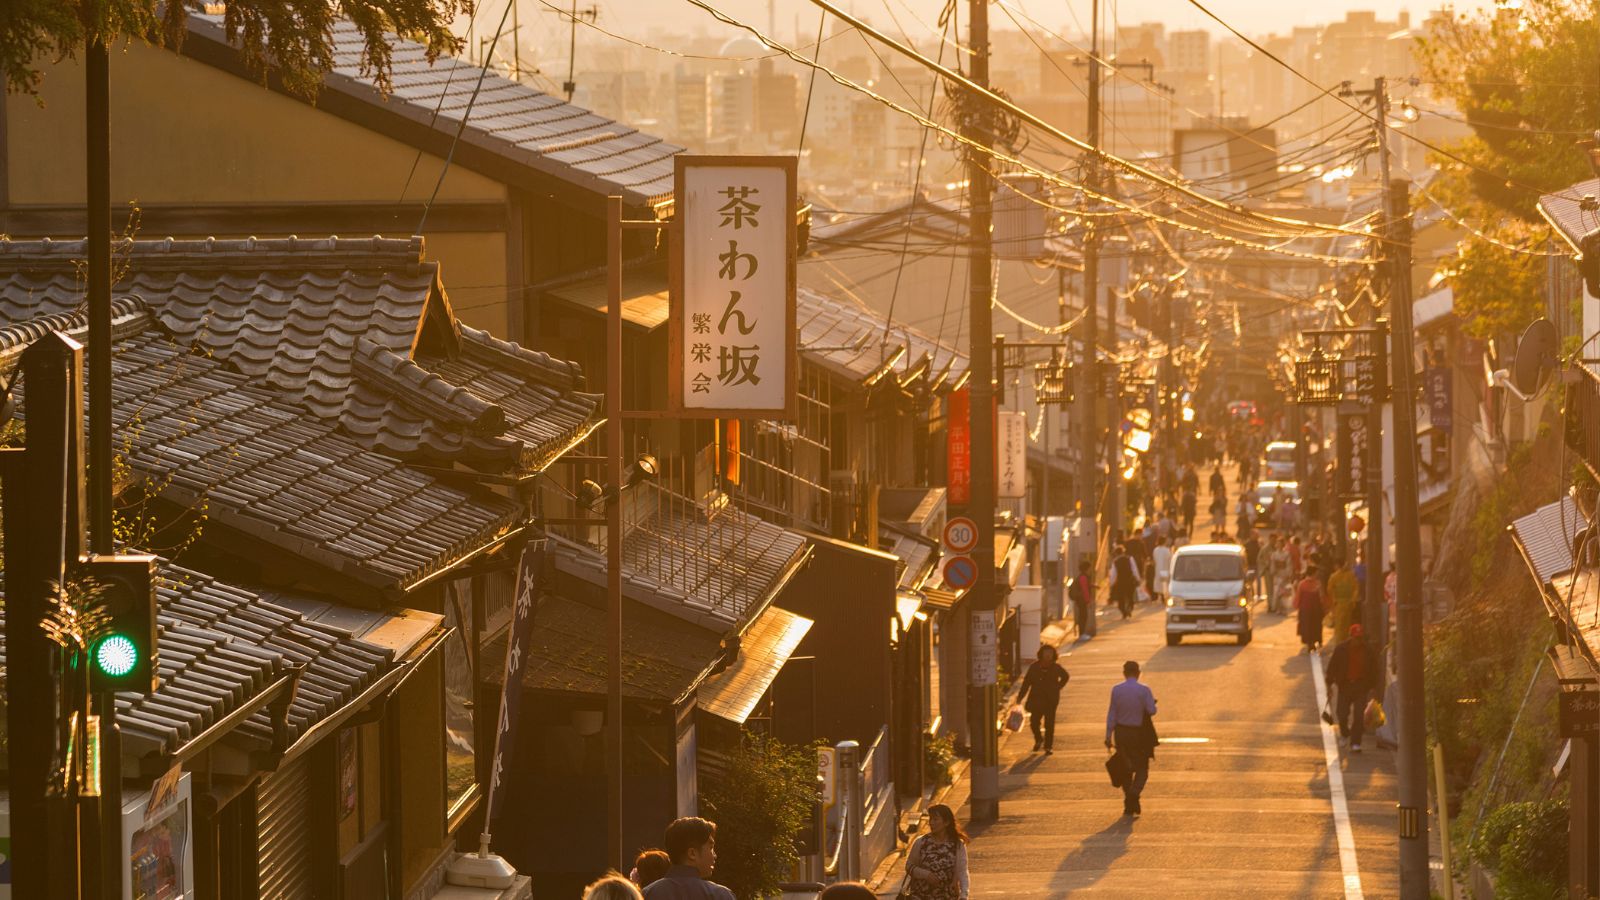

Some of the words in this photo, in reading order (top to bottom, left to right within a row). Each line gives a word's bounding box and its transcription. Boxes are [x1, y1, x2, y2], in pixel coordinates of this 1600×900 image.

[717, 186, 761, 387] 茶わん坂
[690, 312, 712, 394] 繁栄会
[951, 528, 971, 543] 30
